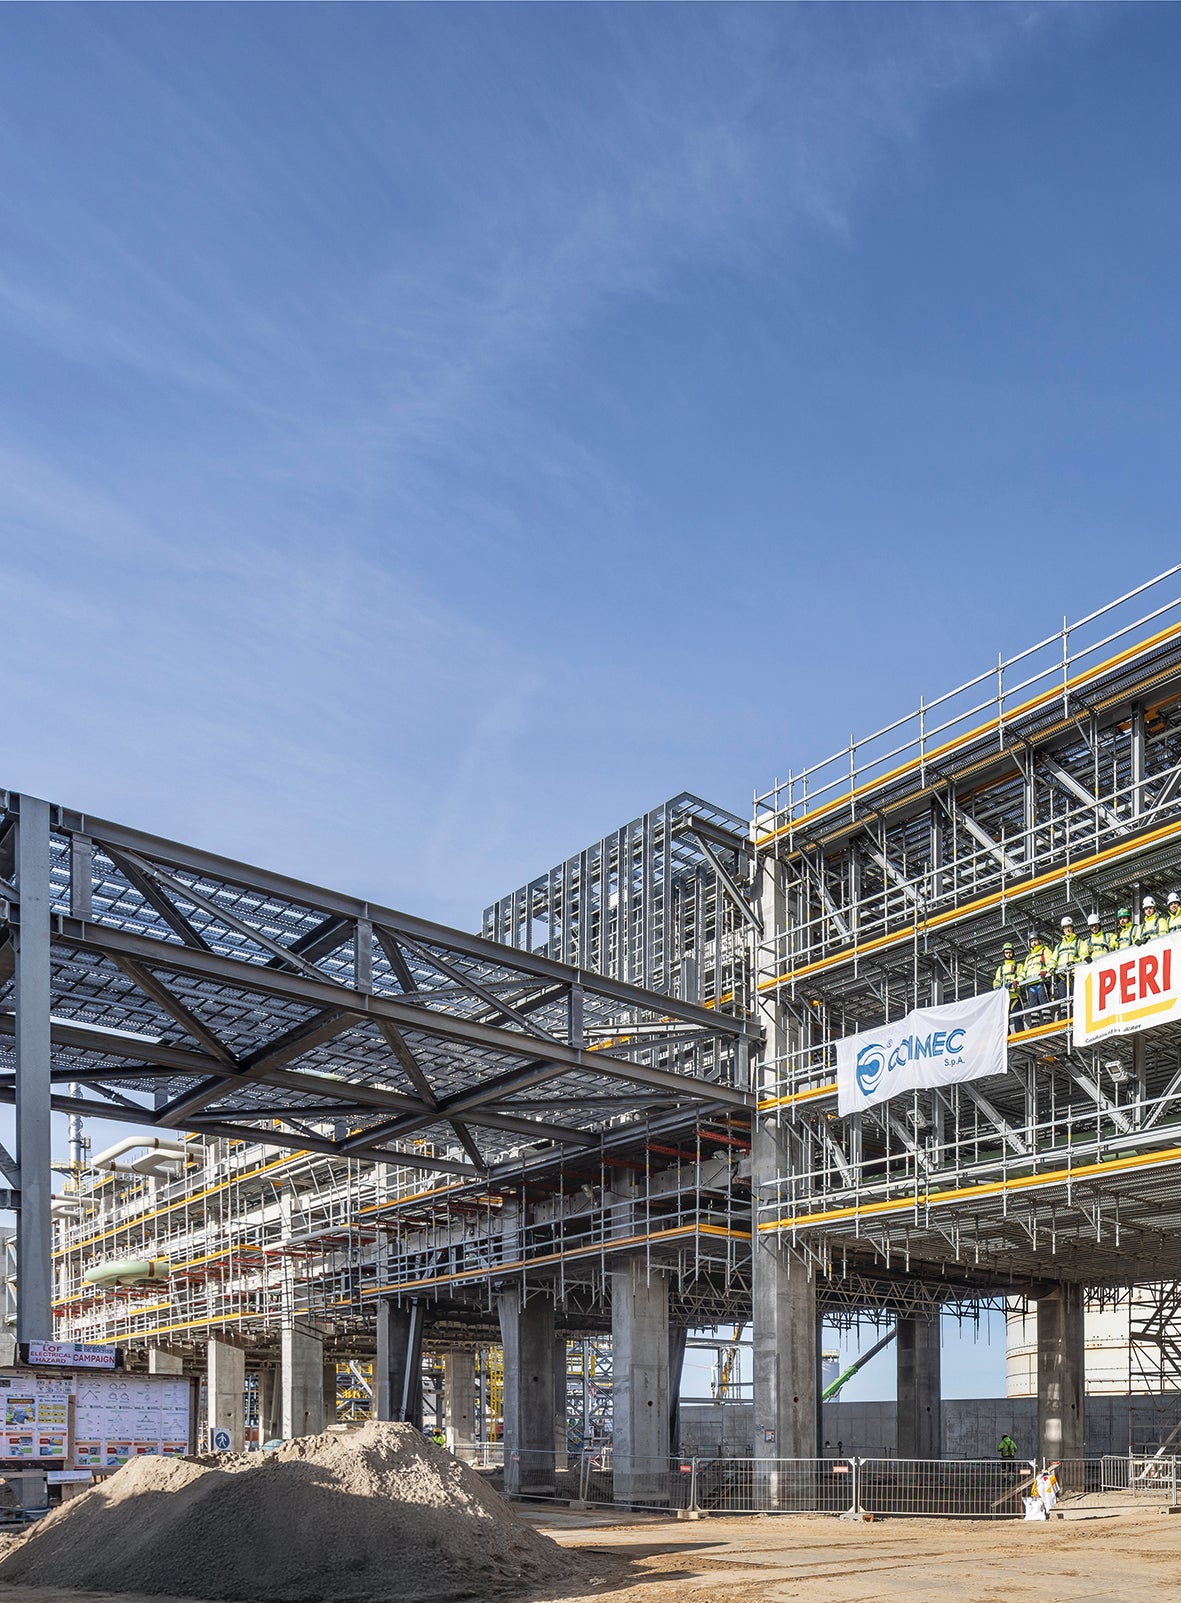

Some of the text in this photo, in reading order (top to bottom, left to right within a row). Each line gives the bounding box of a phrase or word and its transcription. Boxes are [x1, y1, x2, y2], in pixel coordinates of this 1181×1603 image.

[1098, 948, 1172, 1012] PERI
[943, 1056, 966, 1068] S.p.A.
[42, 1344, 63, 1352] LOF
[30, 1350, 72, 1359] ELECTRICAL
[72, 1353, 115, 1364] CAMPAIGN
